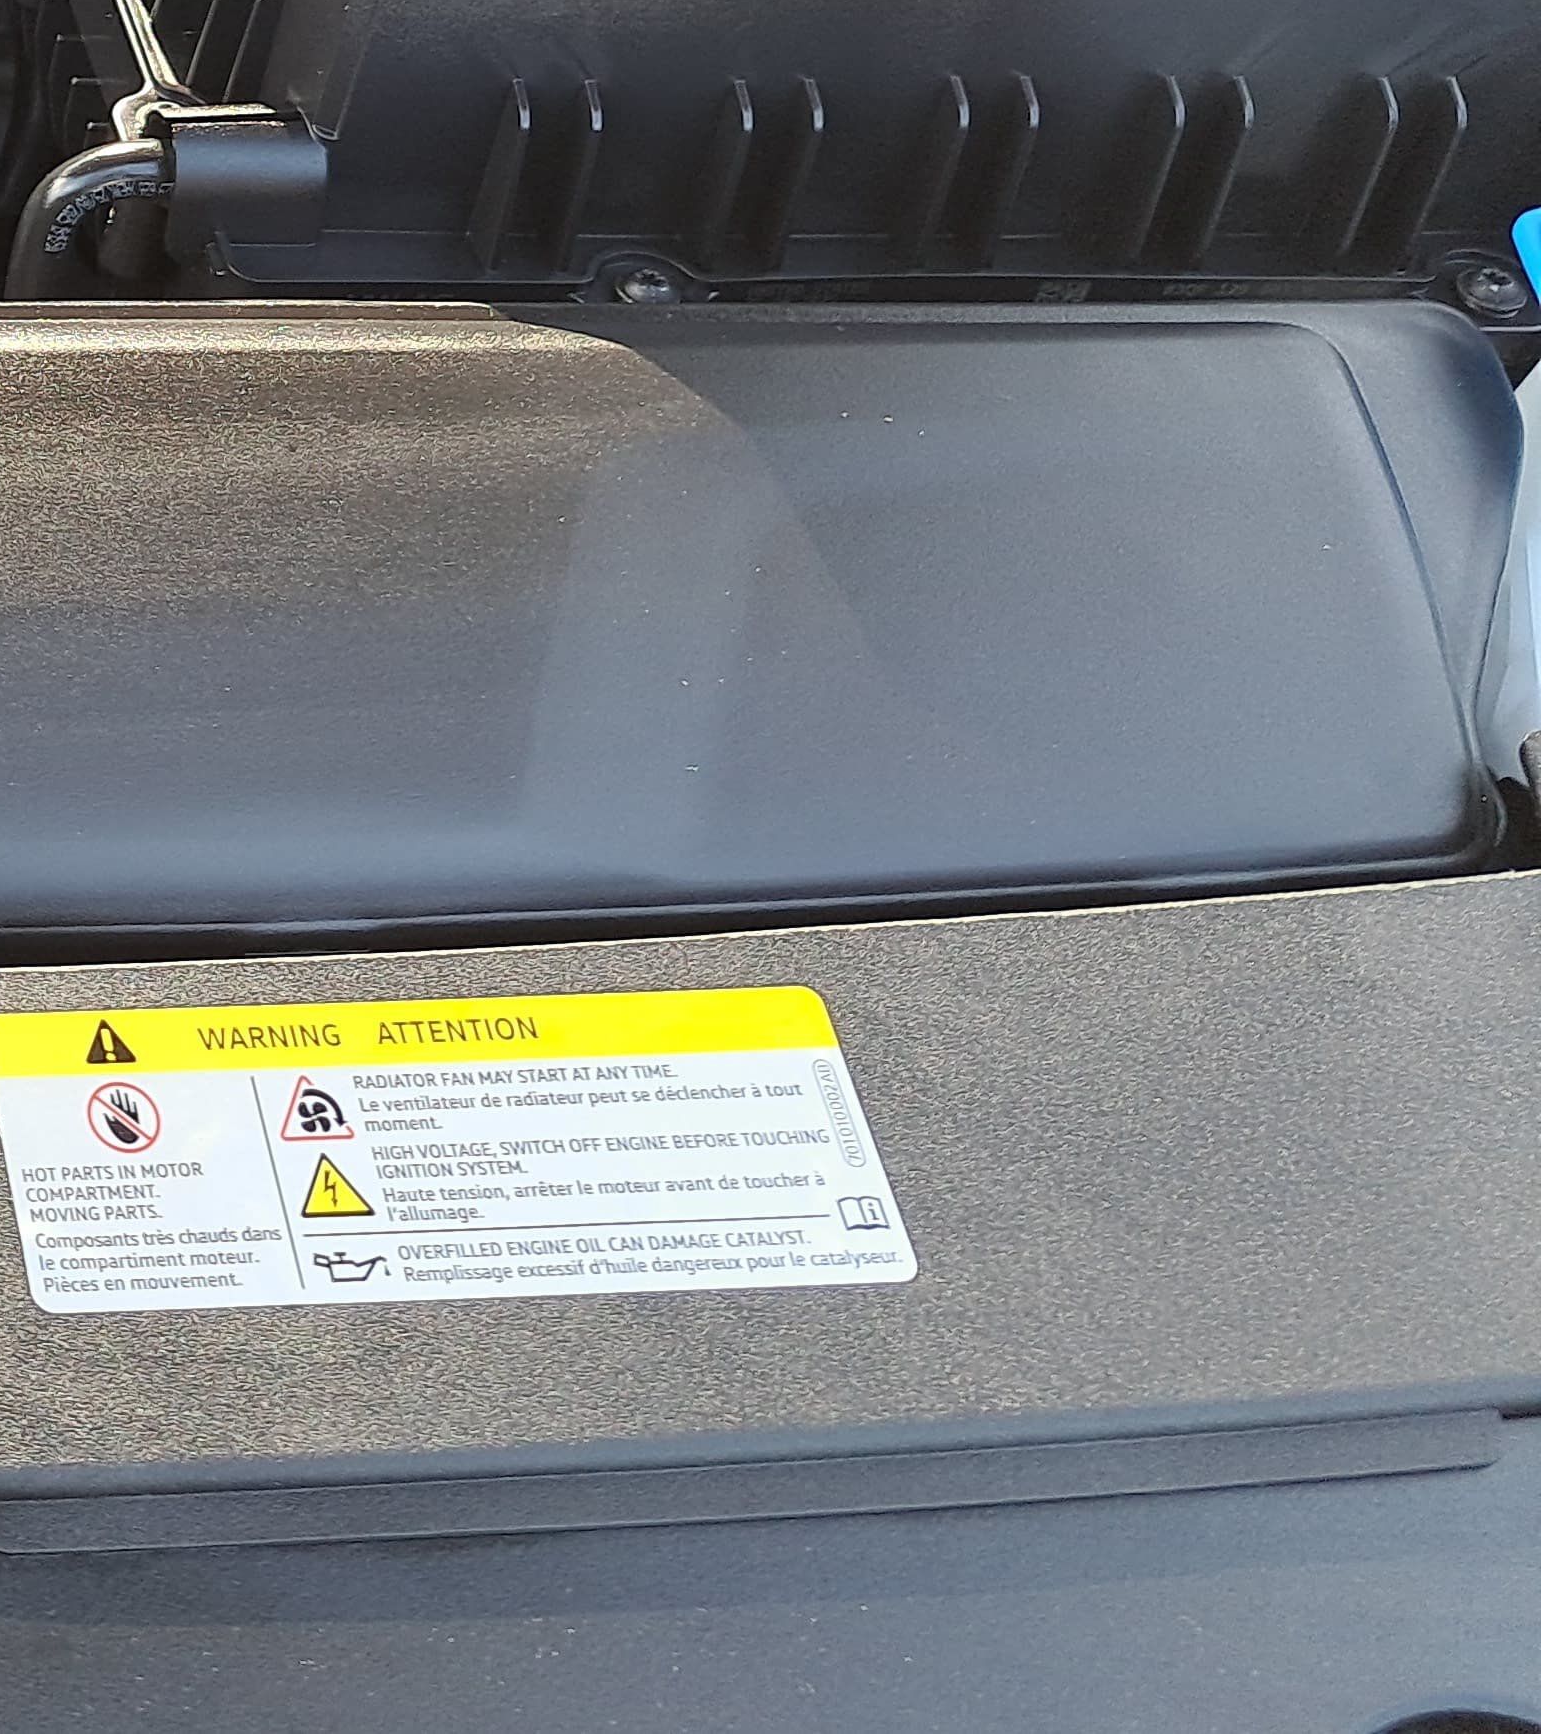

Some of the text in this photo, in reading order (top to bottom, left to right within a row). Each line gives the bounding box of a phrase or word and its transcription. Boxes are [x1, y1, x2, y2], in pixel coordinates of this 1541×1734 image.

[197, 1016, 538, 1050] WARNING ATTENTION
[352, 1063, 678, 1089] RADIATOR FAN MAY START AT ANY TIME.
[357, 1082, 803, 1112] Le ventilateur de radiateur peut se déclencher à tout
[364, 1116, 443, 1131] moment.
[370, 1128, 830, 1160] HIGH VOLTAGE, SWITCH OFF ENGINE BEFORE TOUCHING
[20, 1161, 204, 1182] HOT PARTS IN MOTOR
[375, 1160, 528, 1179] IGNITION SYSTEM.
[25, 1183, 160, 1202] COMPARTMENT.
[381, 1170, 825, 1202] Haute tension, arrêter le moteur avant de toucher à
[29, 1203, 163, 1222] MOVING PARTS.
[386, 1205, 485, 1223] l'allumage.
[34, 1225, 282, 1249] Composants très chauds dans
[397, 1229, 811, 1260] OVERFILLED ENGINE OIL CAN DAMAGE CATALYST.
[38, 1250, 260, 1271] le compartiment moteur.
[402, 1249, 902, 1283] Remplissage excessif d'huile dangereux pour le catalyseur.
[42, 1272, 243, 1292] Pièces en mouvement.
